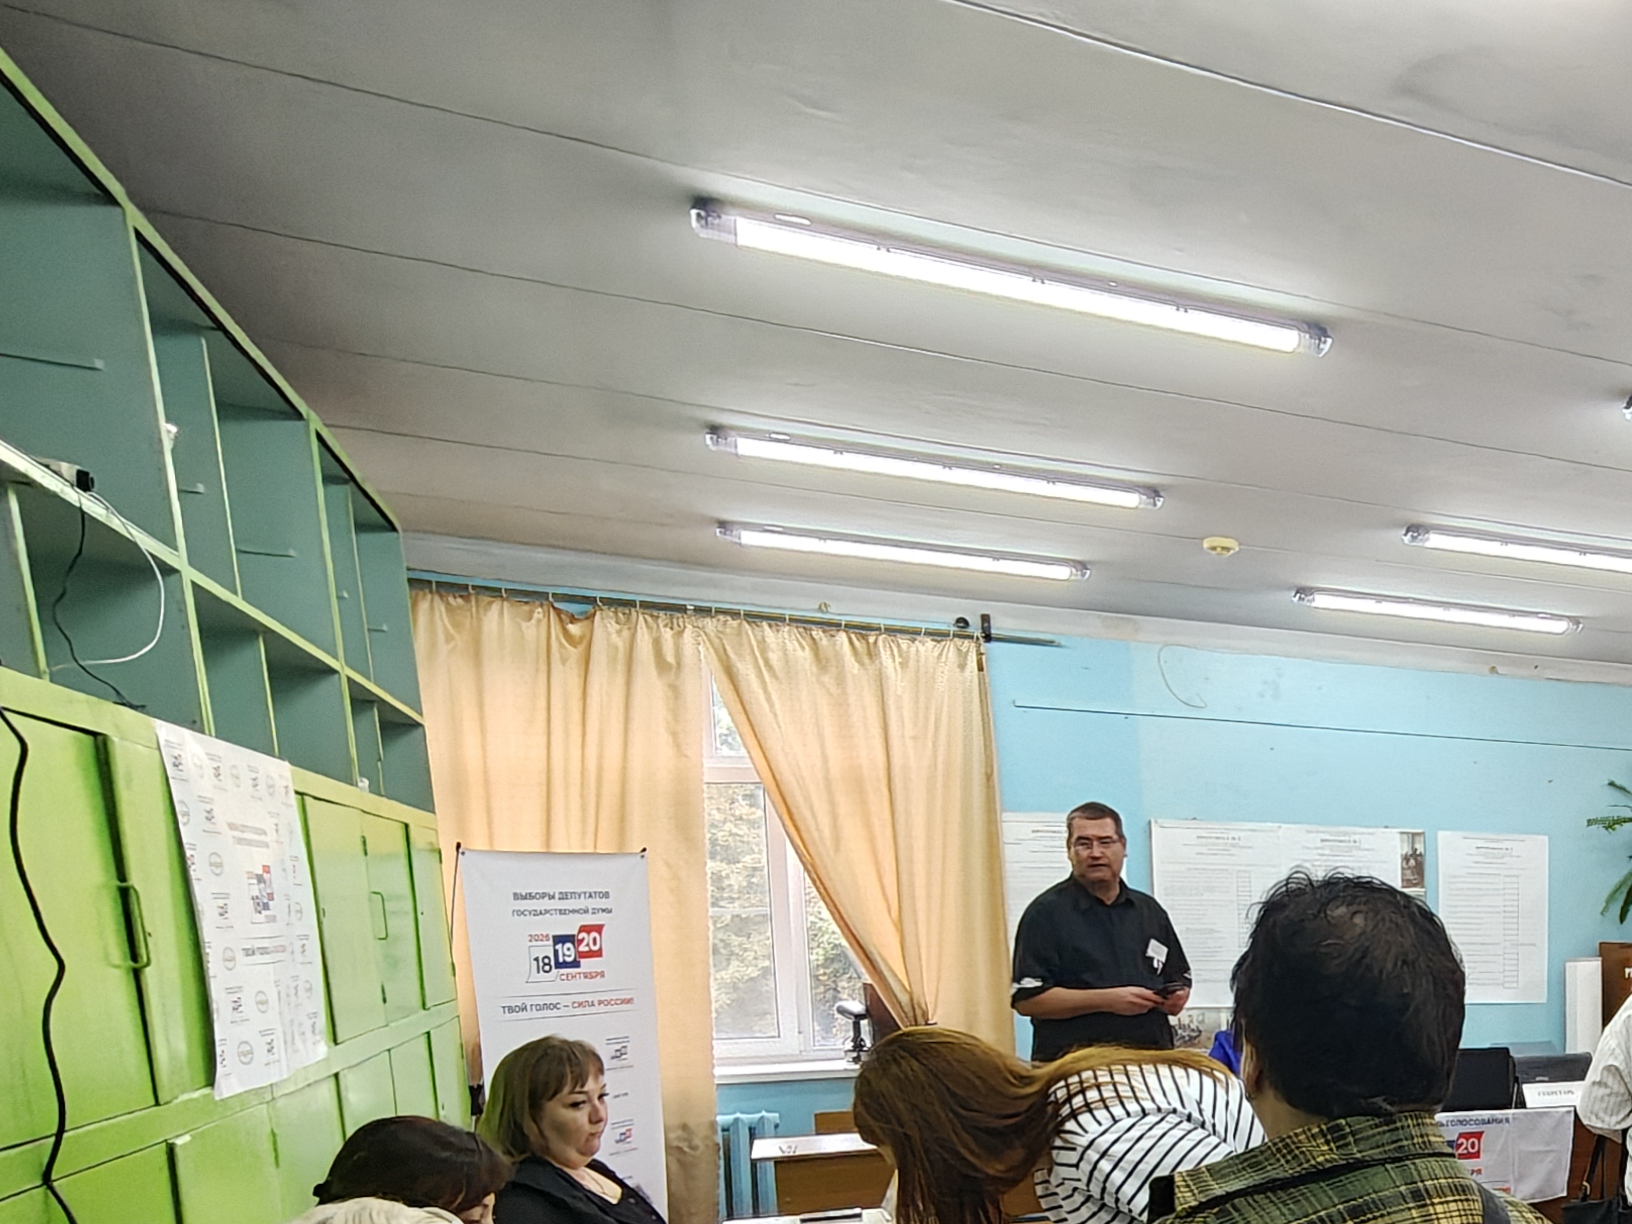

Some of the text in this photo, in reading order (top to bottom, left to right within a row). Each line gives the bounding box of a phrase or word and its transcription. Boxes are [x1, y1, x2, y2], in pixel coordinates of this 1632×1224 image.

[513, 890, 610, 901] ВЫБОРЫ ДЕПУТАТОВ
[533, 931, 600, 974] 18 19 20
[560, 970, 605, 981] СЕНТЯБРЯ
[501, 1002, 528, 1015] ТВОЙ
[530, 1002, 561, 1012] ГОЛОС
[571, 1000, 595, 1009] СИЛА
[1457, 1138, 1478, 1154] 20
